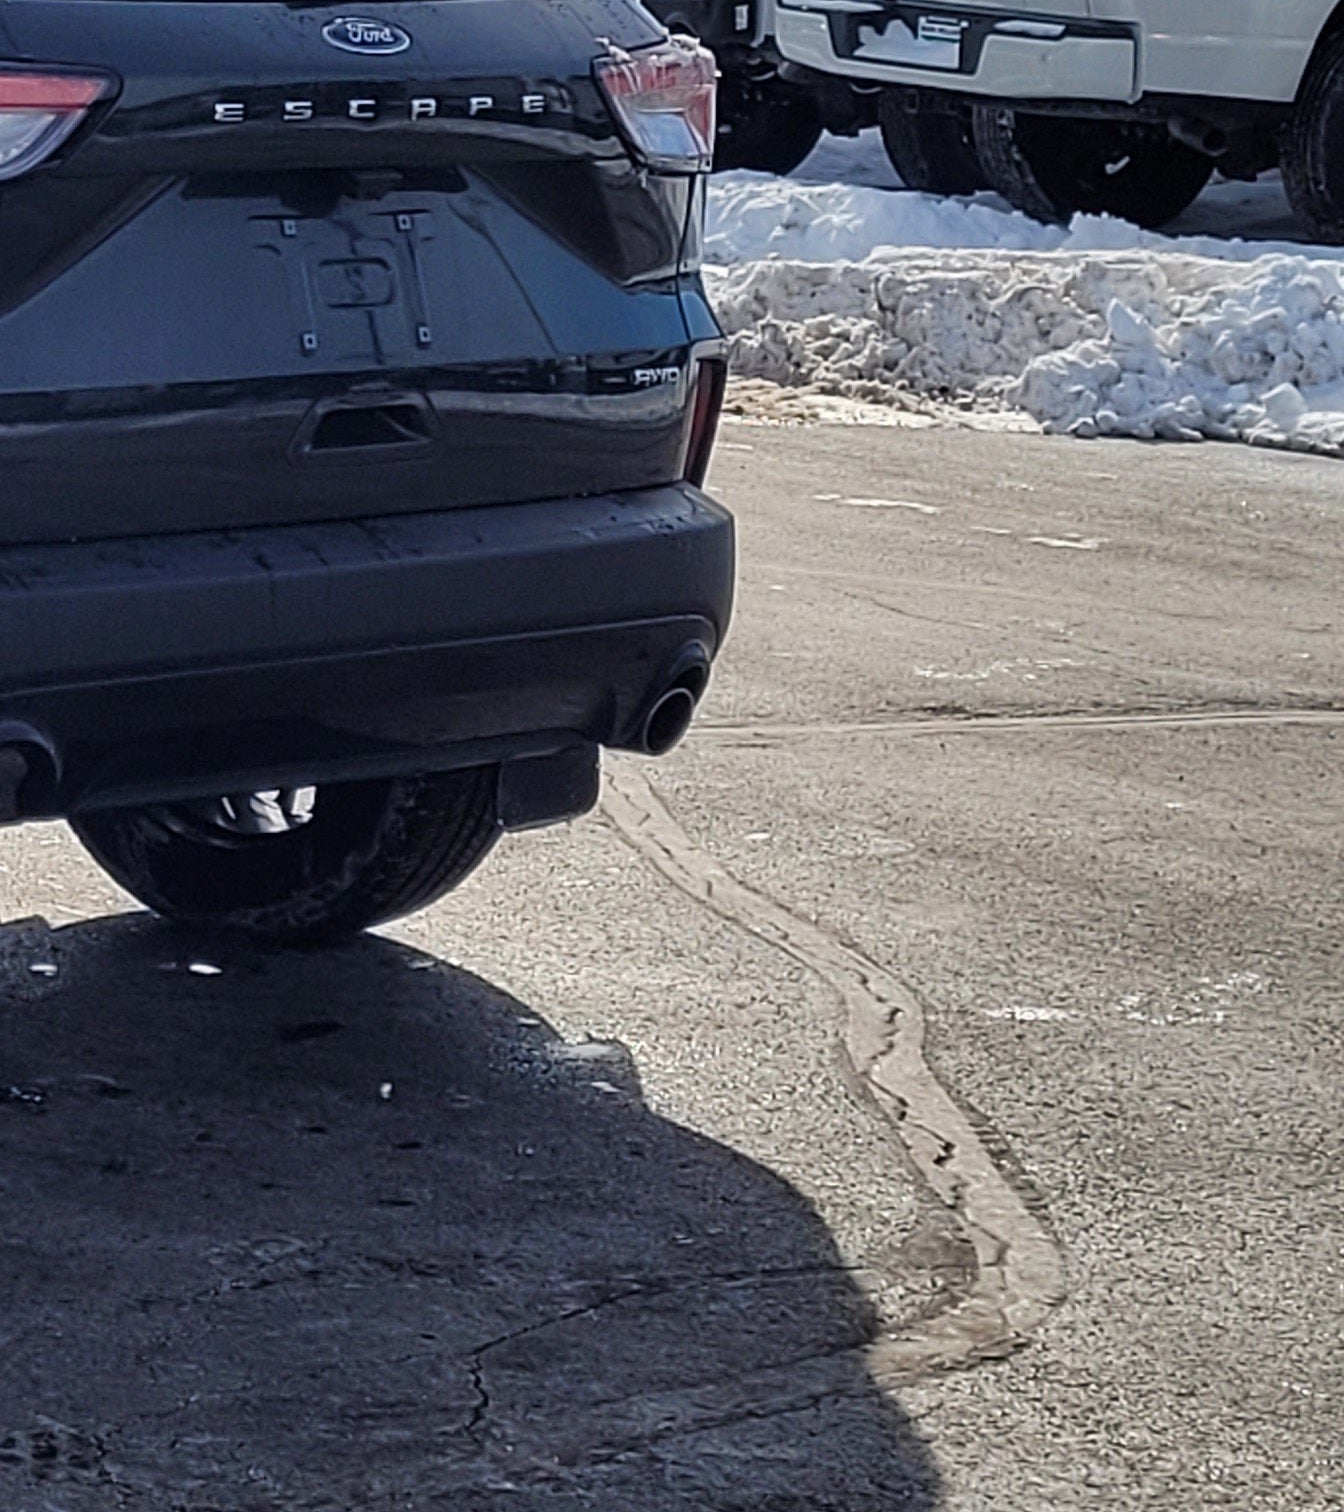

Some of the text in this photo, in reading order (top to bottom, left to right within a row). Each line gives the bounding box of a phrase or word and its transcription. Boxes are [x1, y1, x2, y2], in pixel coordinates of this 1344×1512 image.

[345, 23, 395, 43] Ford
[214, 94, 545, 122] ESCAPE
[634, 367, 681, 387] AWD
